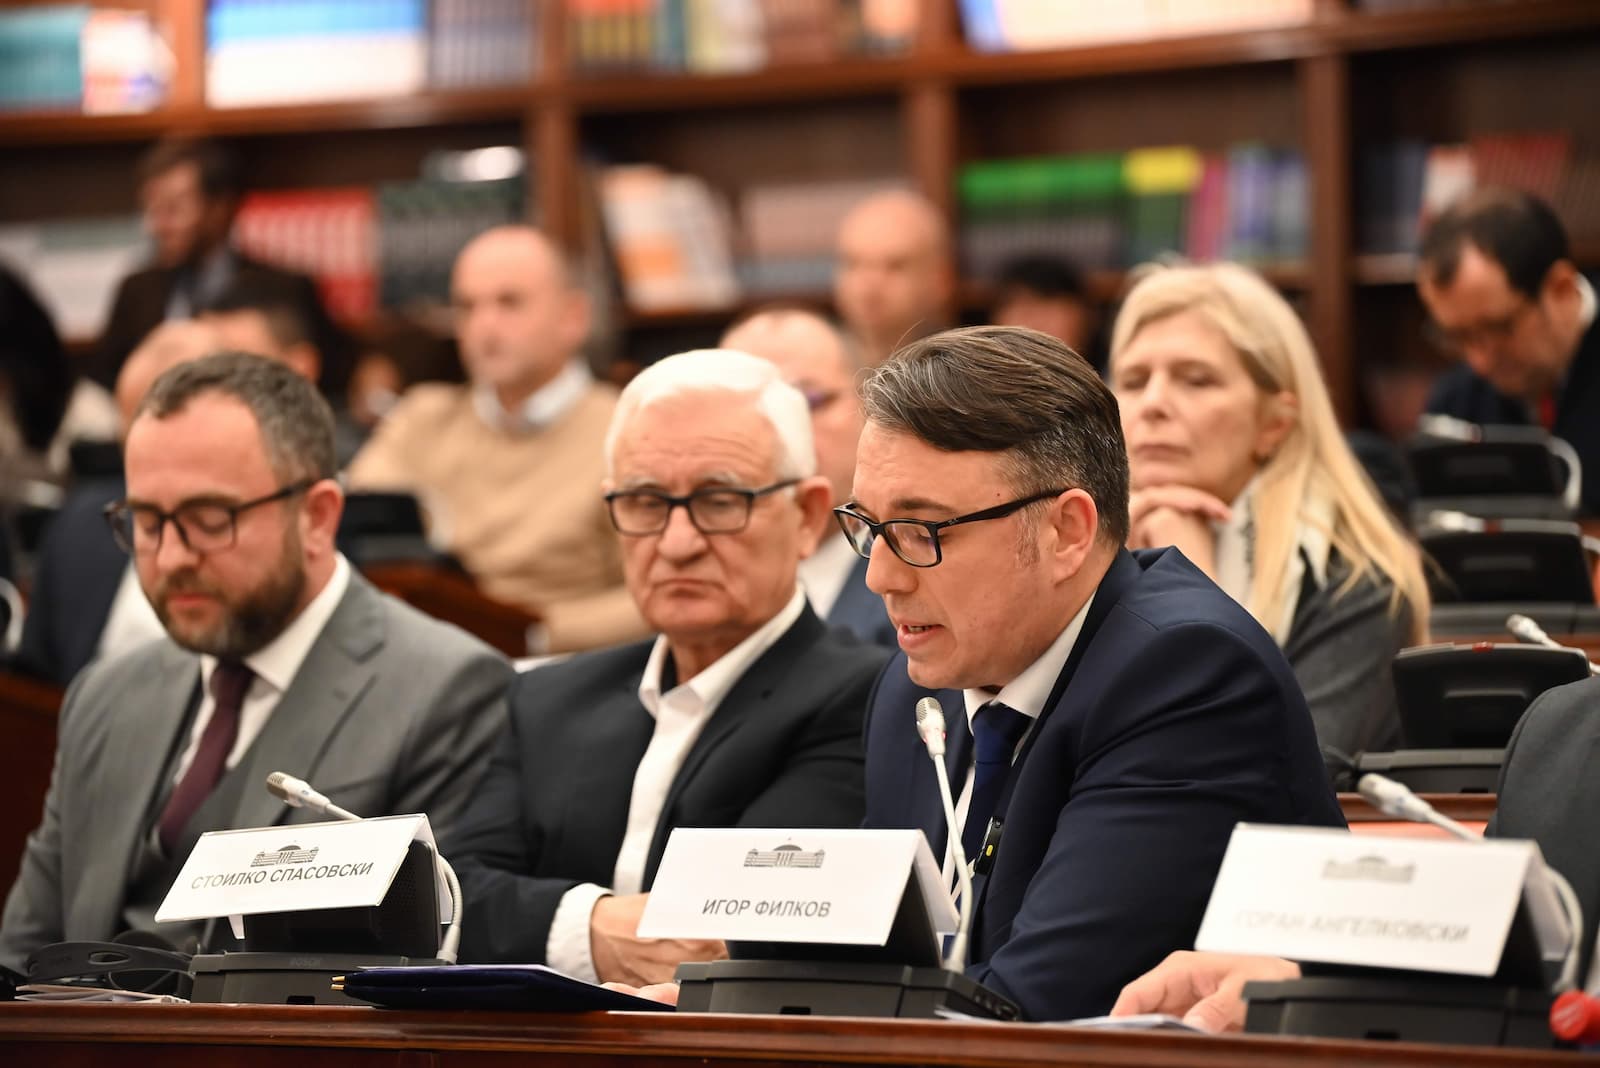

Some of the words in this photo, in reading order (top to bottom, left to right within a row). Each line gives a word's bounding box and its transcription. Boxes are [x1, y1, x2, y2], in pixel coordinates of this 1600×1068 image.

[191, 870, 267, 890] СТОИЛКО
[269, 862, 375, 883] СПАСОВСКИ
[702, 899, 751, 916] ИГОР
[754, 899, 832, 918] ФИЛКОВ
